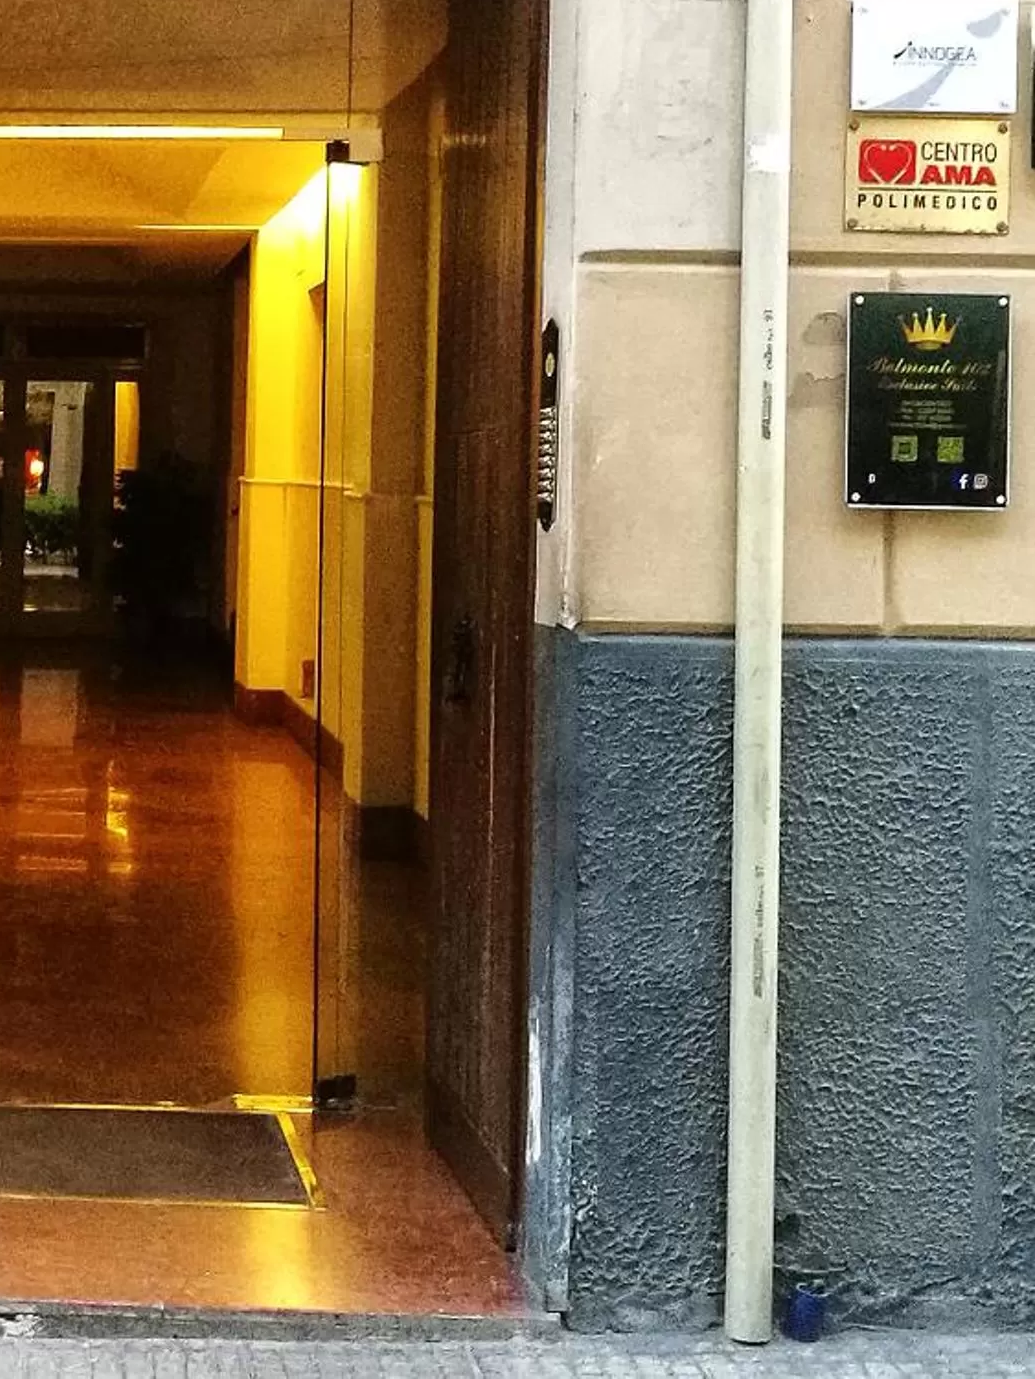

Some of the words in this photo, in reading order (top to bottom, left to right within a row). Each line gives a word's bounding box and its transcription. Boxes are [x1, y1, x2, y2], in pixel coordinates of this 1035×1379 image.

[920, 141, 998, 164] CENTRO
[920, 164, 998, 187] AMA
[857, 193, 998, 211] POLIMEDICO
